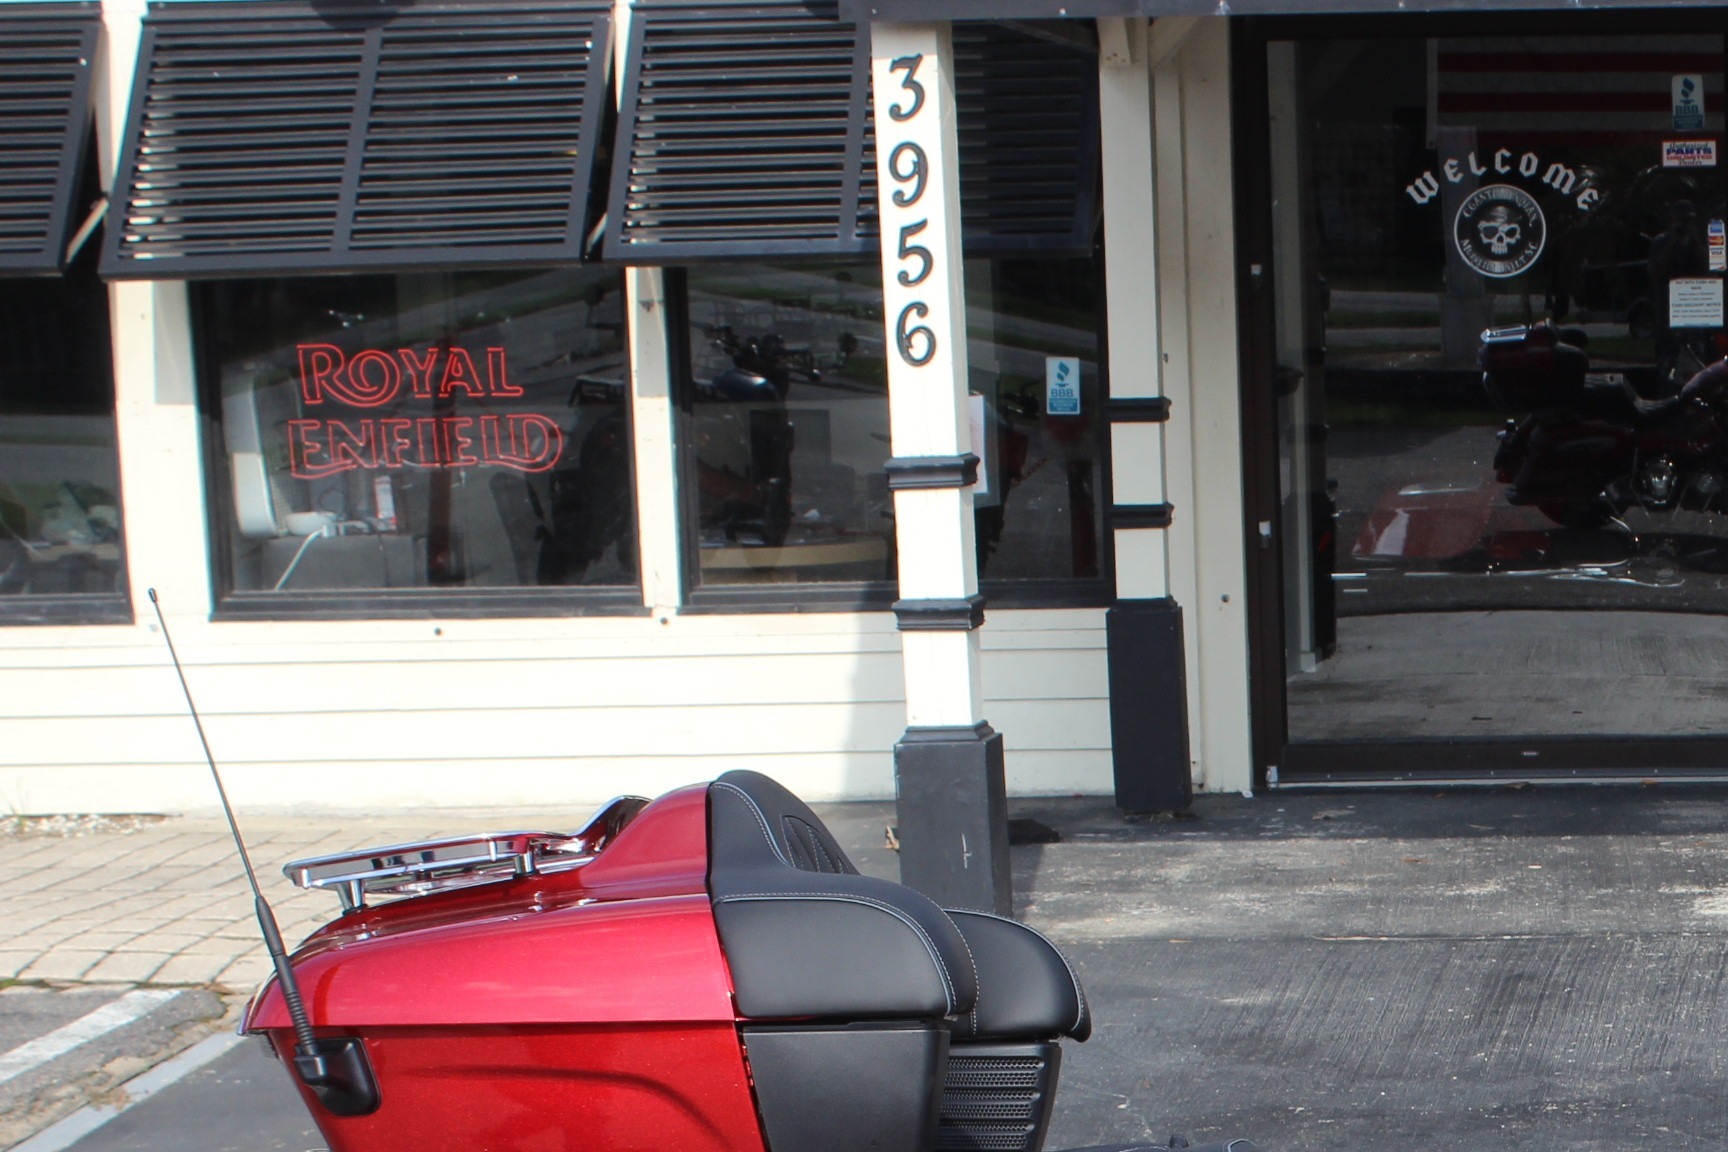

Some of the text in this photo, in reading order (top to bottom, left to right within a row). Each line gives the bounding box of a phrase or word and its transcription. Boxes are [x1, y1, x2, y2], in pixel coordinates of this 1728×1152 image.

[1675, 105, 1698, 114] BBB
[888, 54, 937, 367] 3956
[296, 343, 525, 408] ROYAL
[1050, 388, 1074, 398] BBB
[287, 413, 565, 480] ENFIELD
